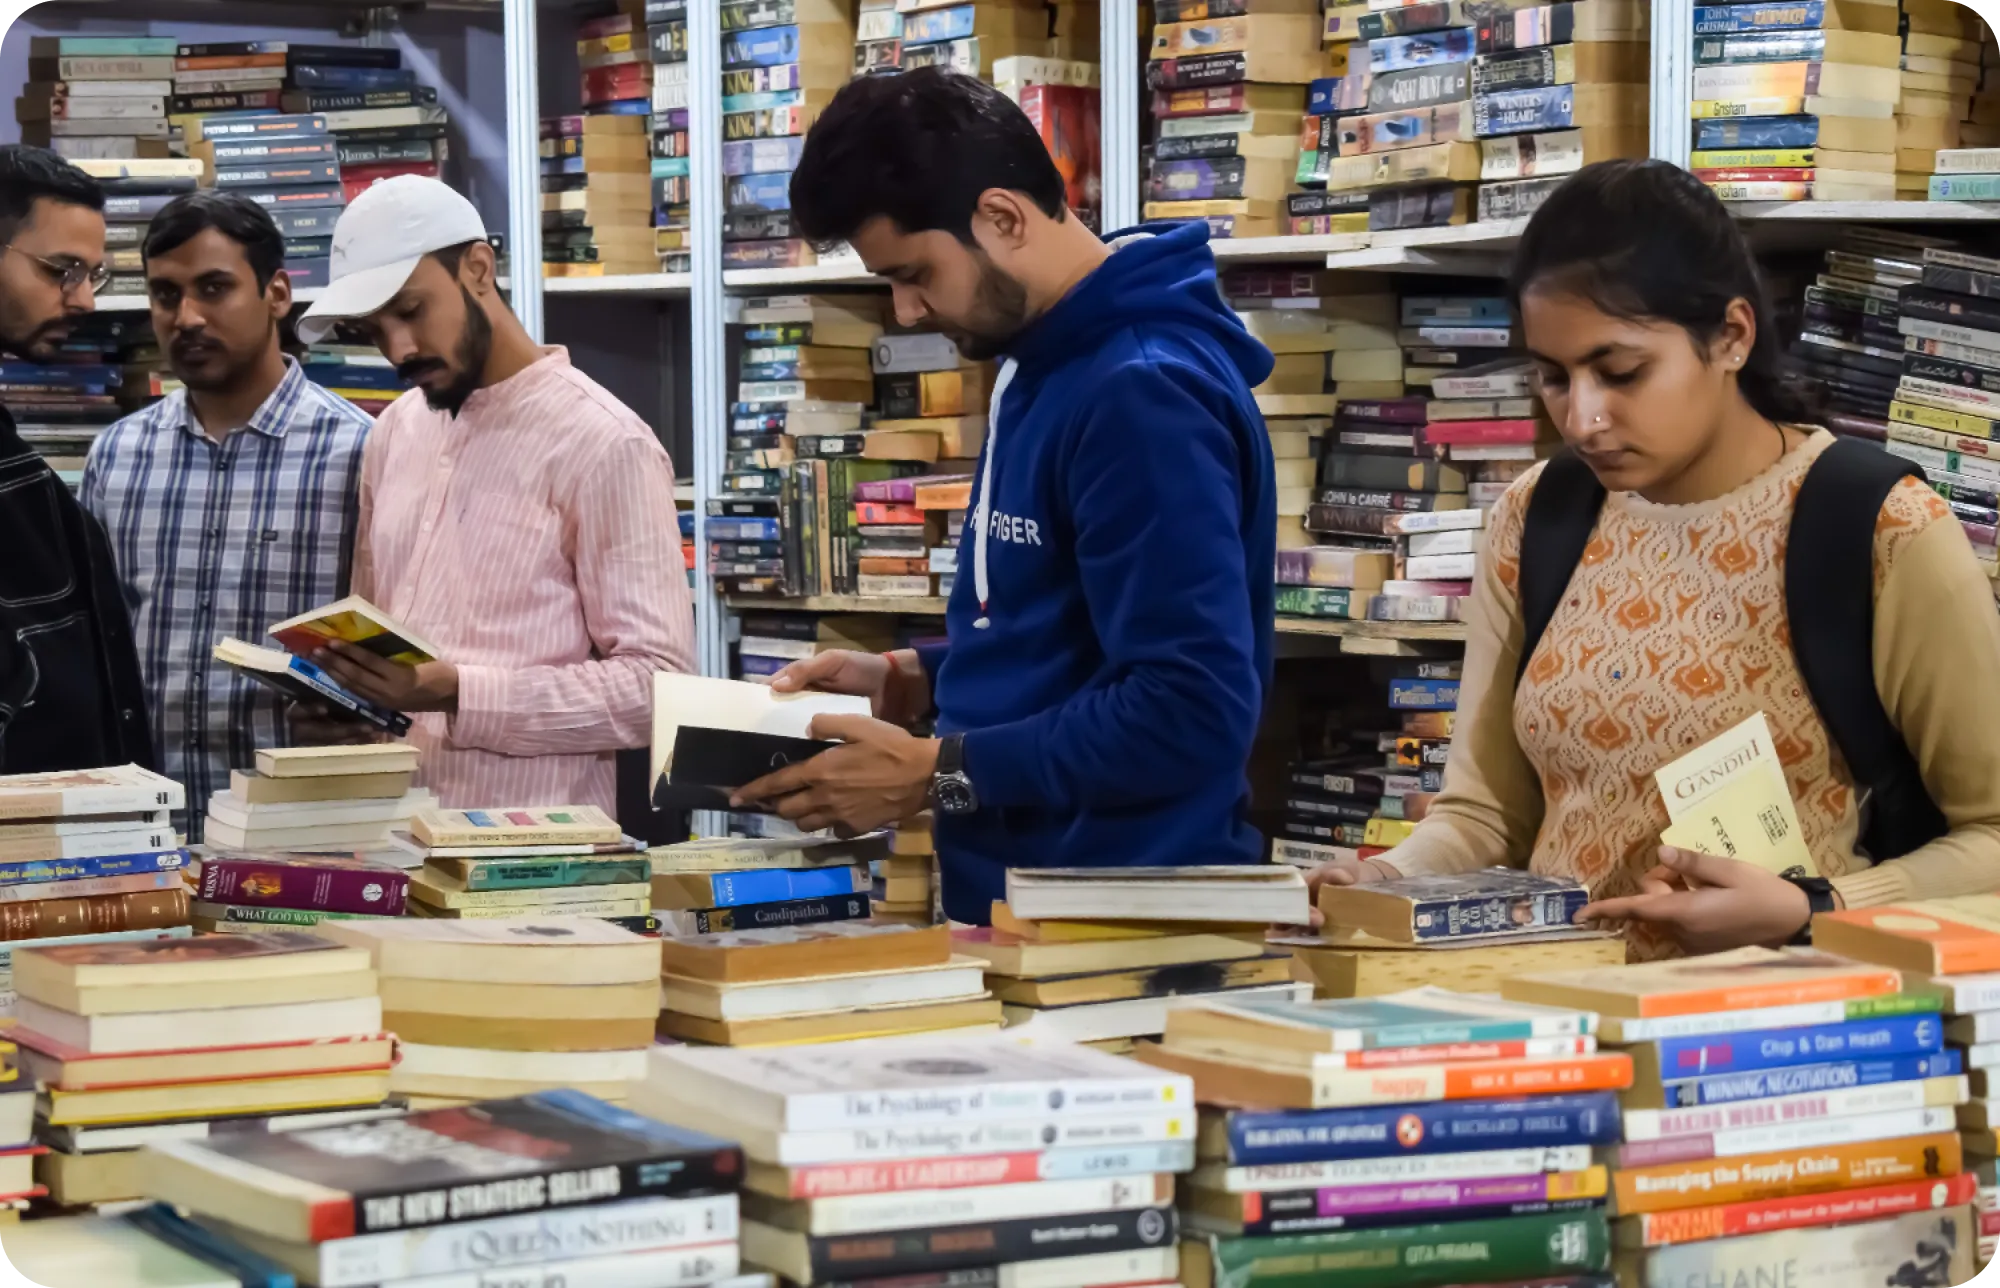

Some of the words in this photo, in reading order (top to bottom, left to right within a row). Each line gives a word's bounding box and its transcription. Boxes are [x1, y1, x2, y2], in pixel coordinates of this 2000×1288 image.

[1695, 20, 1739, 33] GRISHAM
[1703, 8, 1731, 20] JOHN
[1496, 94, 1542, 110] WINTER'S
[1714, 102, 1747, 116] Grisham
[1322, 489, 1348, 505] JOHN
[1349, 492, 1357, 502] le
[1358, 490, 1392, 508] CARRÉ
[1276, 599, 1312, 613] CHILD
[1282, 590, 1302, 602] LEE
[1393, 687, 1436, 706] Patterson
[1674, 738, 1762, 800] GANDHI
[235, 909, 266, 921] WHAT
[267, 911, 292, 922] GOD
[1760, 1038, 1795, 1058] Chip
[1798, 1036, 1812, 1053] &
[1815, 1033, 1845, 1051] Dan
[1849, 1029, 1892, 1048] Heath
[1702, 1076, 1766, 1102] WINNING
[1767, 1063, 1858, 1094] NEGOTIATIONS
[846, 1095, 873, 1116] The
[877, 1092, 962, 1117] Psychology
[969, 1092, 984, 1108] of
[1659, 1106, 1724, 1136] MAKING
[1727, 1103, 1776, 1128] WORK
[1781, 1097, 1829, 1121] WORK
[1451, 1116, 1520, 1136] RICHARD
[1522, 1114, 1569, 1133] SHELL
[854, 1131, 880, 1150] The
[885, 1126, 963, 1153] Psychology
[969, 1124, 984, 1143] of
[804, 1169, 888, 1194] PROJECT
[894, 1157, 1011, 1190] LEADERSHIP
[1635, 1168, 1713, 1194] Managing
[1713, 1165, 1739, 1185] the
[1741, 1159, 1795, 1184] Supply
[1796, 1154, 1840, 1176] Chain
[364, 1195, 400, 1231] THE
[402, 1189, 448, 1226] NEW
[448, 1174, 547, 1219] STRATEGIC
[547, 1165, 621, 1206] SELLING
[1746, 1209, 1763, 1226] The
[1763, 1206, 1788, 1223] Don't
[1789, 1204, 1814, 1220] Sweat
[1814, 1202, 1830, 1217] the
[1830, 1200, 1855, 1216] Small
[1855, 1197, 1877, 1215] Stuff
[466, 1222, 562, 1264] QUEEN
[575, 1213, 686, 1248] NOTHING
